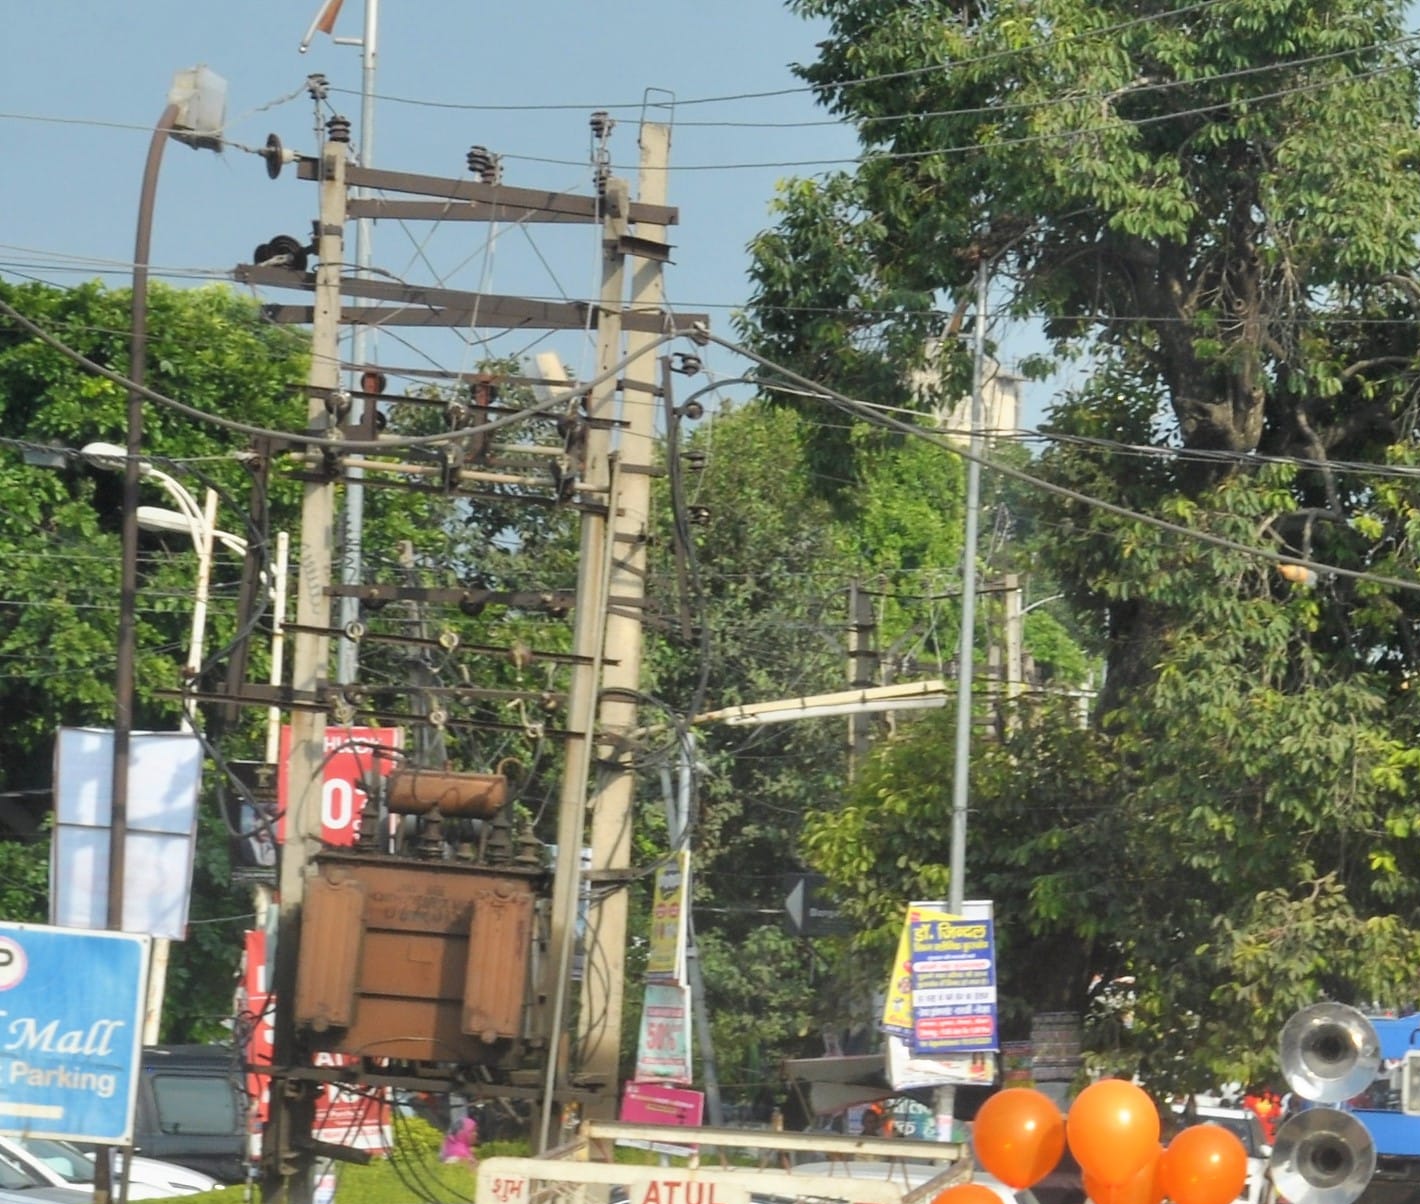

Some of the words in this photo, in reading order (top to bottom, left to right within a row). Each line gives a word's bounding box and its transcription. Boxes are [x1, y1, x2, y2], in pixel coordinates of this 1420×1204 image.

[5, 1018, 126, 1057] Mall
[9, 1061, 116, 1098] Parking
[491, 1177, 525, 1204] शुभ
